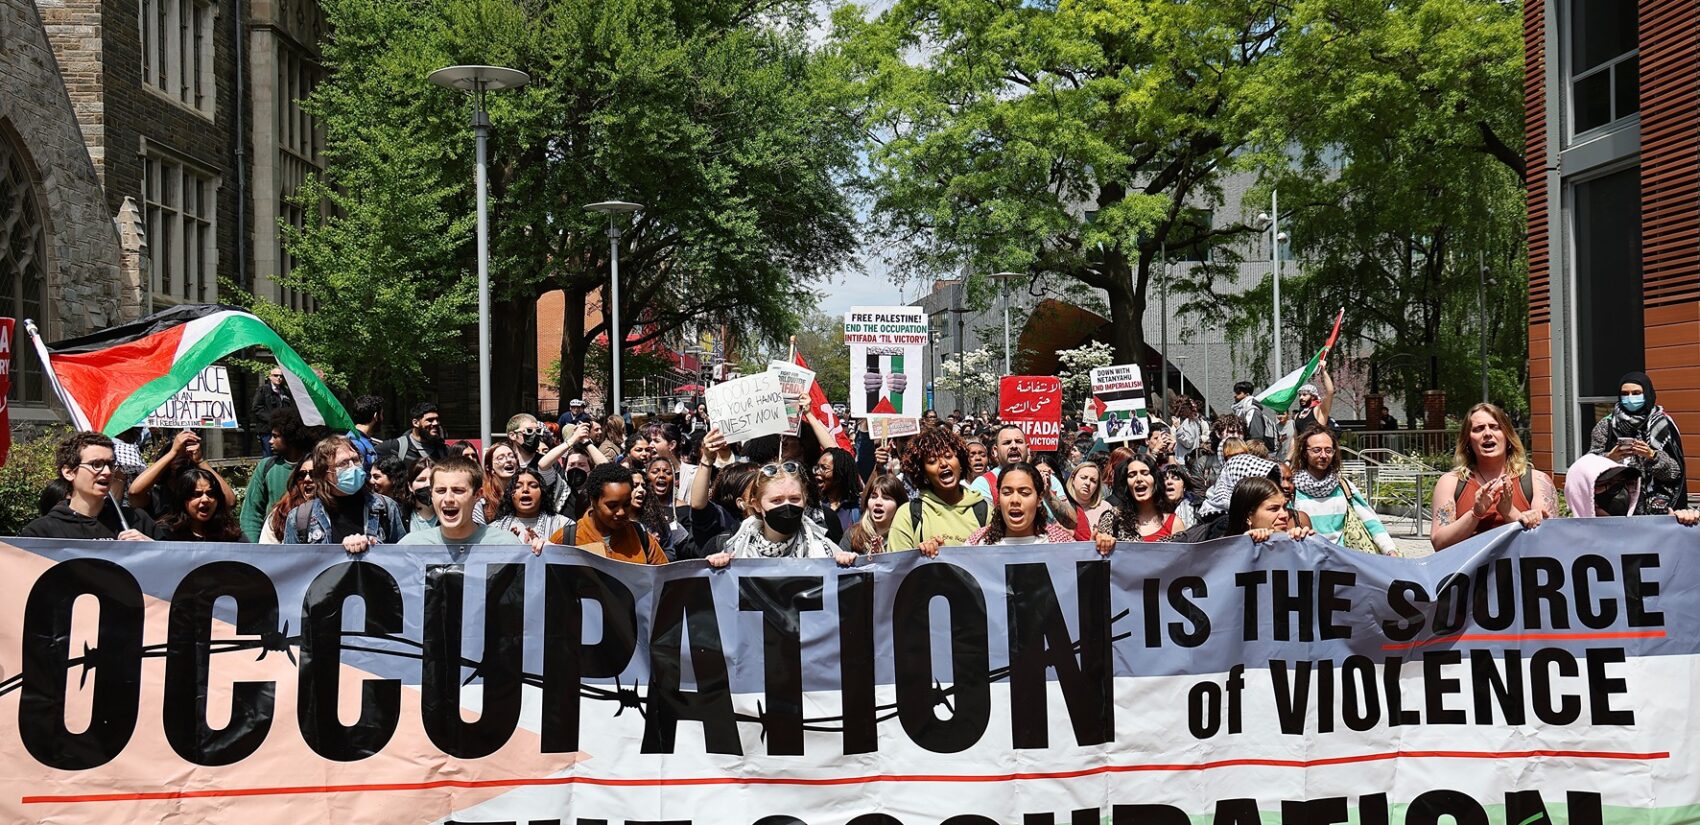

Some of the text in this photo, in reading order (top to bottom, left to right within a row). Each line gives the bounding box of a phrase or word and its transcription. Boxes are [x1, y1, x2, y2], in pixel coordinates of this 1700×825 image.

[852, 314, 922, 323] FREE PALESTINE!
[845, 324, 927, 333] END THE OCCUPATION
[845, 334, 877, 342] INTIFADA
[894, 335, 927, 343] VICTORY!
[187, 366, 229, 394] ACE
[755, 376, 770, 392] IS
[1097, 375, 1132, 383] NETANYAHU
[1105, 381, 1143, 390] IMPERIALISM
[181, 392, 193, 400] AN
[728, 397, 754, 416] YOUR
[755, 406, 779, 424] NOW
[1142, 552, 1665, 648] IS THE SOURCE
[18, 557, 1116, 771] OCCUPATION
[1187, 646, 1635, 740] of VIOLENCE
